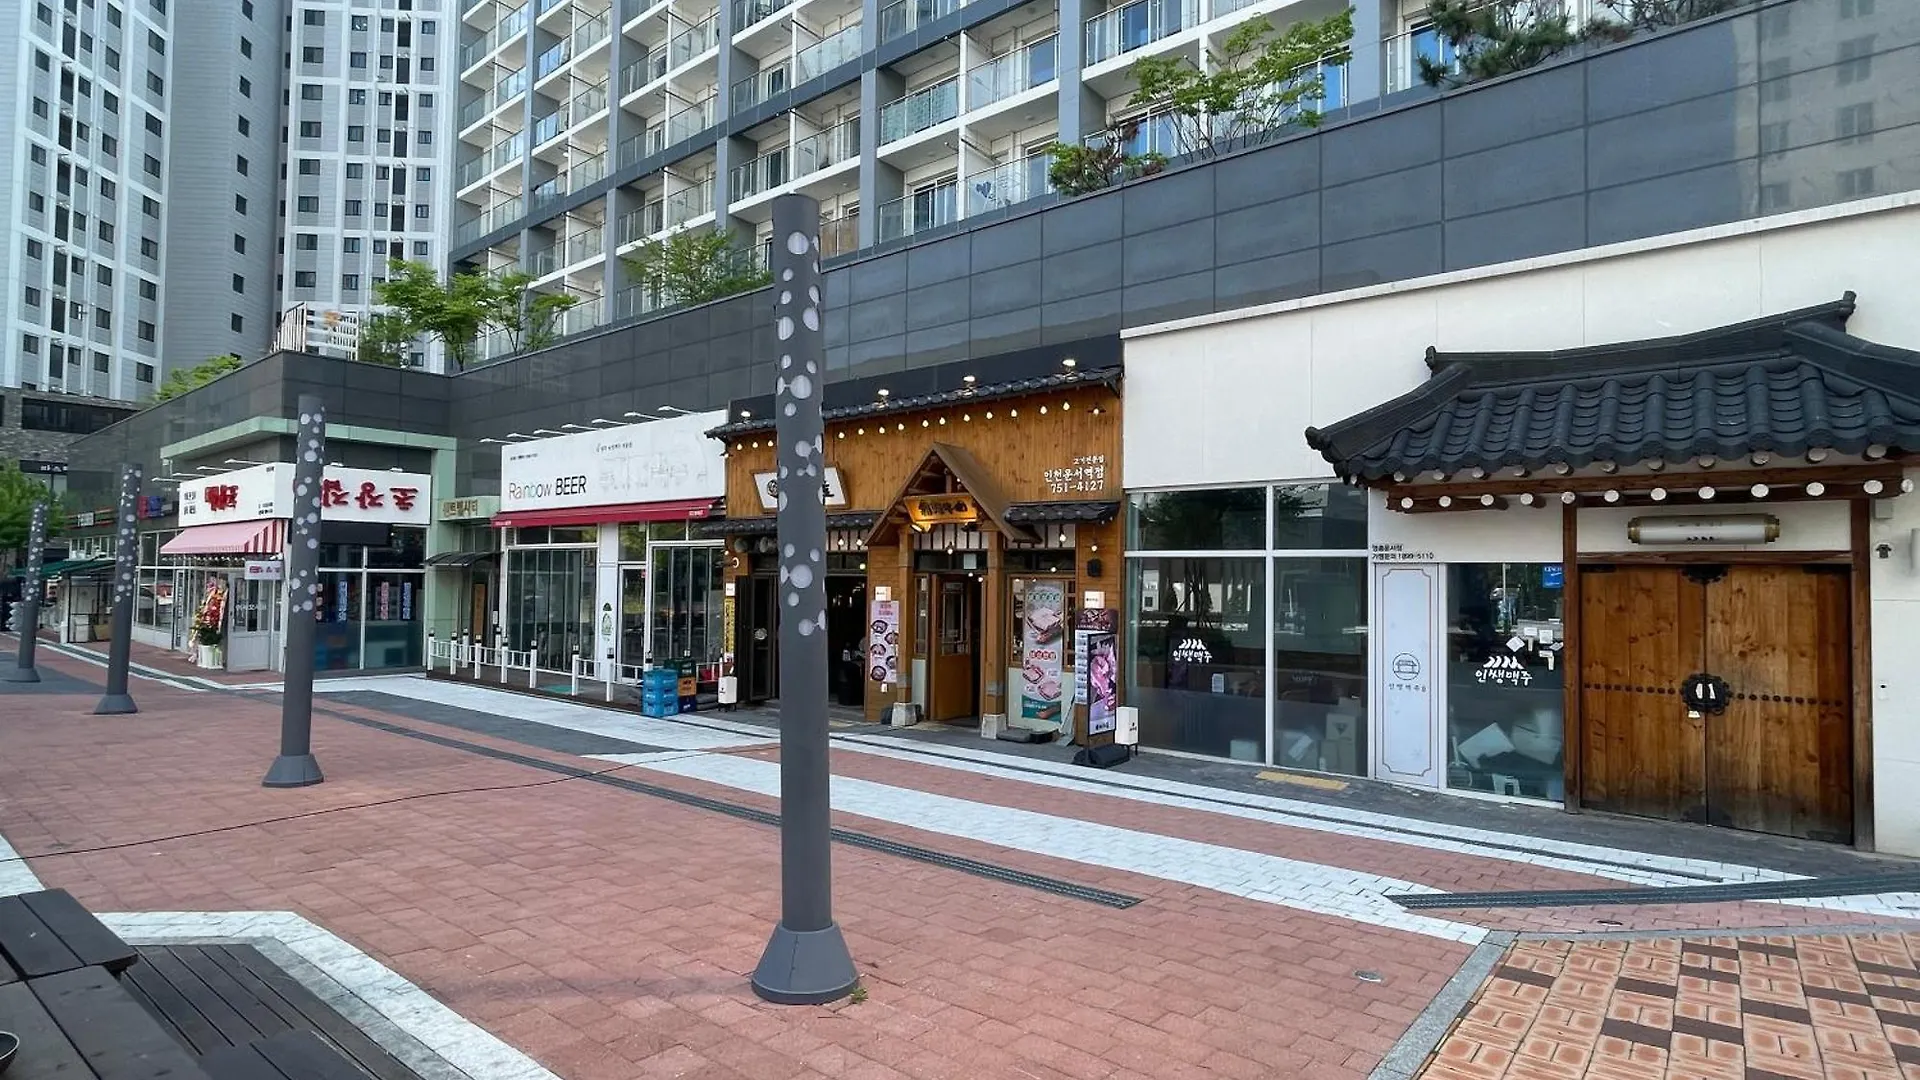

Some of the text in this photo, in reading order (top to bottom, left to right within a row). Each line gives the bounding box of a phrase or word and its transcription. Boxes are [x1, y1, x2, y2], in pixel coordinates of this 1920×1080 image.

[1044, 465, 1104, 482] 인천운서역점
[509, 475, 587, 500] Ranbow BEER
[1051, 480, 1104, 493] 751-4127
